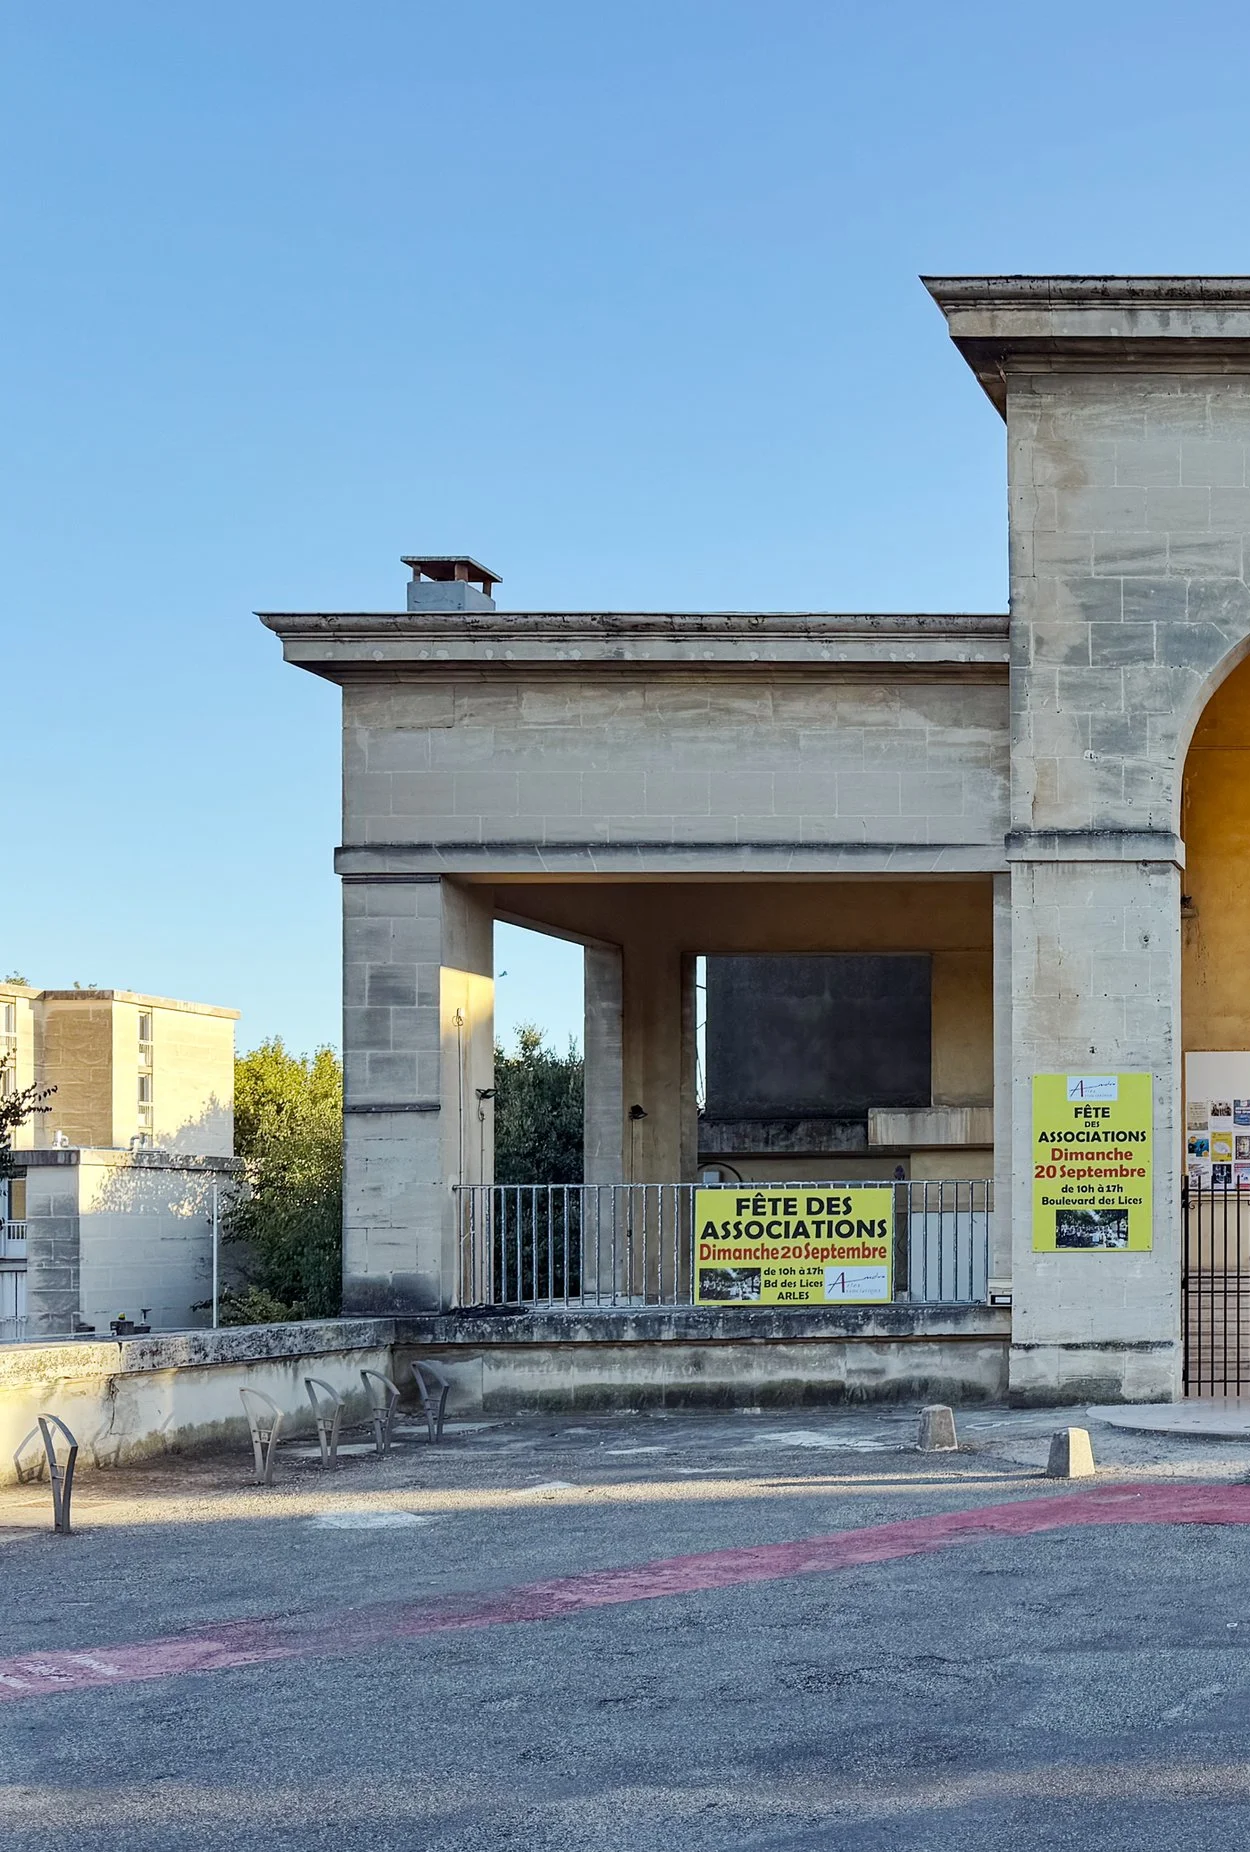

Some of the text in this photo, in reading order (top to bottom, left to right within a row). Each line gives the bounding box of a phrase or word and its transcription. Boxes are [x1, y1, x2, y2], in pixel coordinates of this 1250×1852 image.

[1074, 1104, 1110, 1118] FÊTE
[1038, 1130, 1147, 1143] ASSOCIATIONS
[1051, 1148, 1133, 1161] Dimanche
[1034, 1164, 1146, 1181] 20 Septembre
[1061, 1184, 1123, 1193] de 10h à 17h
[736, 1192, 852, 1217] FÊTE DES
[1041, 1196, 1142, 1205] Boulevard des Lices
[700, 1219, 887, 1240] ASSOCIATIONS
[699, 1241, 887, 1263] Dimanche 20 Septembre
[763, 1267, 824, 1276] de 10h à 17h
[764, 1279, 824, 1288] Bd des Lices
[777, 1291, 810, 1300] ARLES
